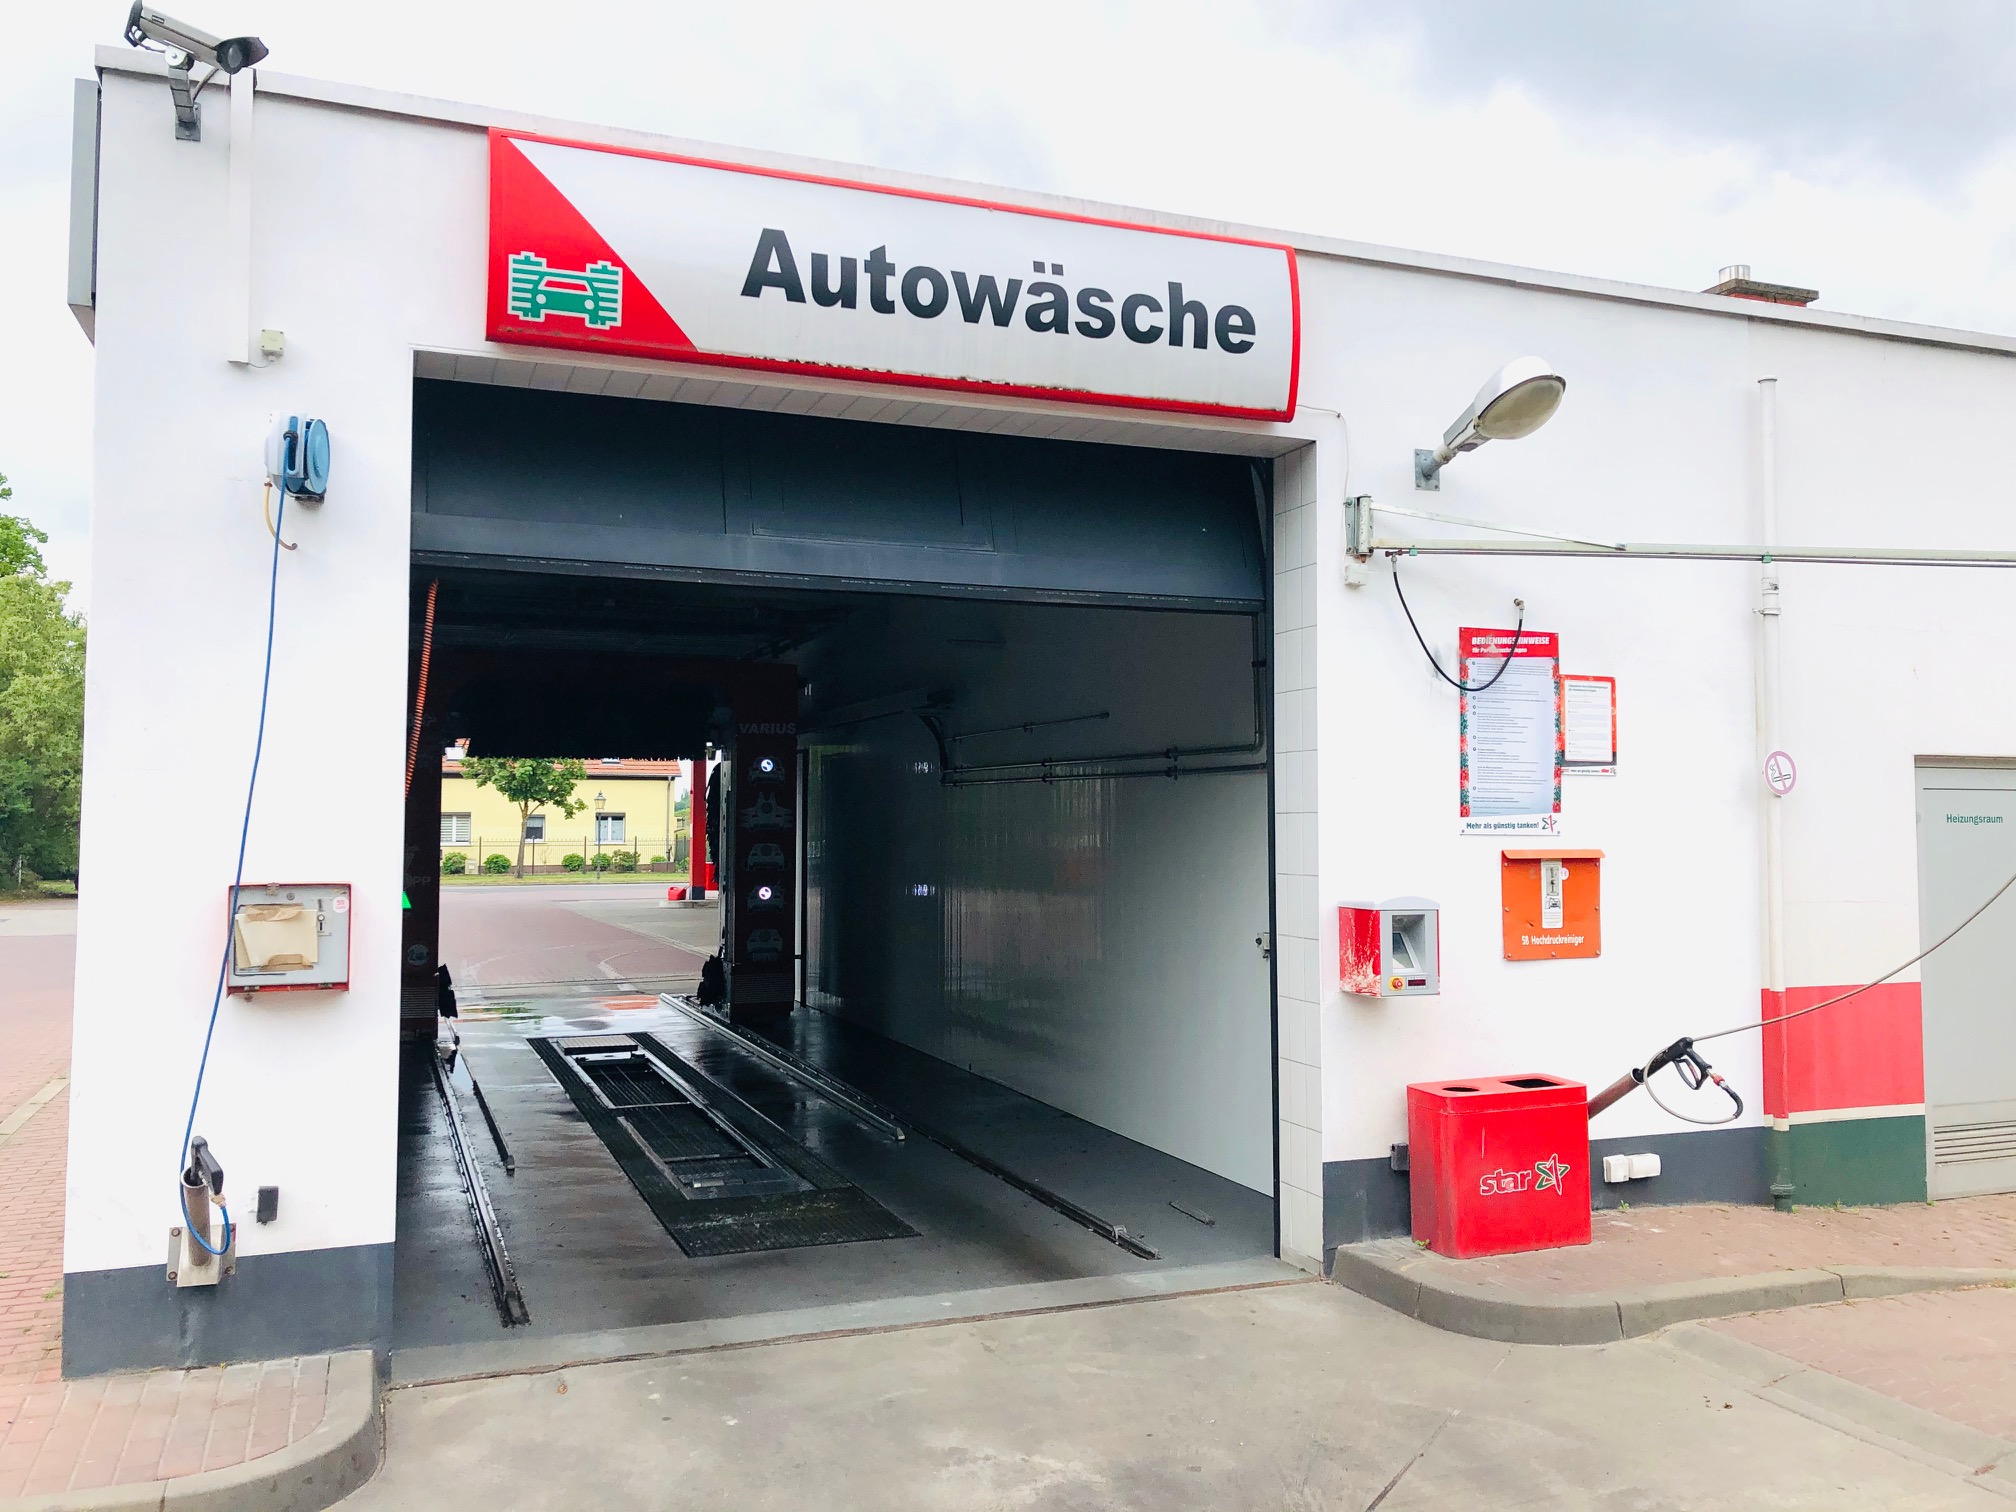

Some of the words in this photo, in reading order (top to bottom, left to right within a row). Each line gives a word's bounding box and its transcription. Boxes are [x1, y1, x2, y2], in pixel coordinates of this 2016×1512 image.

[740, 227, 1256, 355] Autowäsche
[738, 722, 797, 735] VARIUS
[1466, 822, 1482, 830] Mehr
[1493, 822, 1516, 830] günstig
[1946, 813, 2003, 826] Heizungsraum
[1521, 935, 1530, 946] SB
[1531, 933, 1585, 946] Hochdruckreiniger
[1480, 1168, 1532, 1196] star
